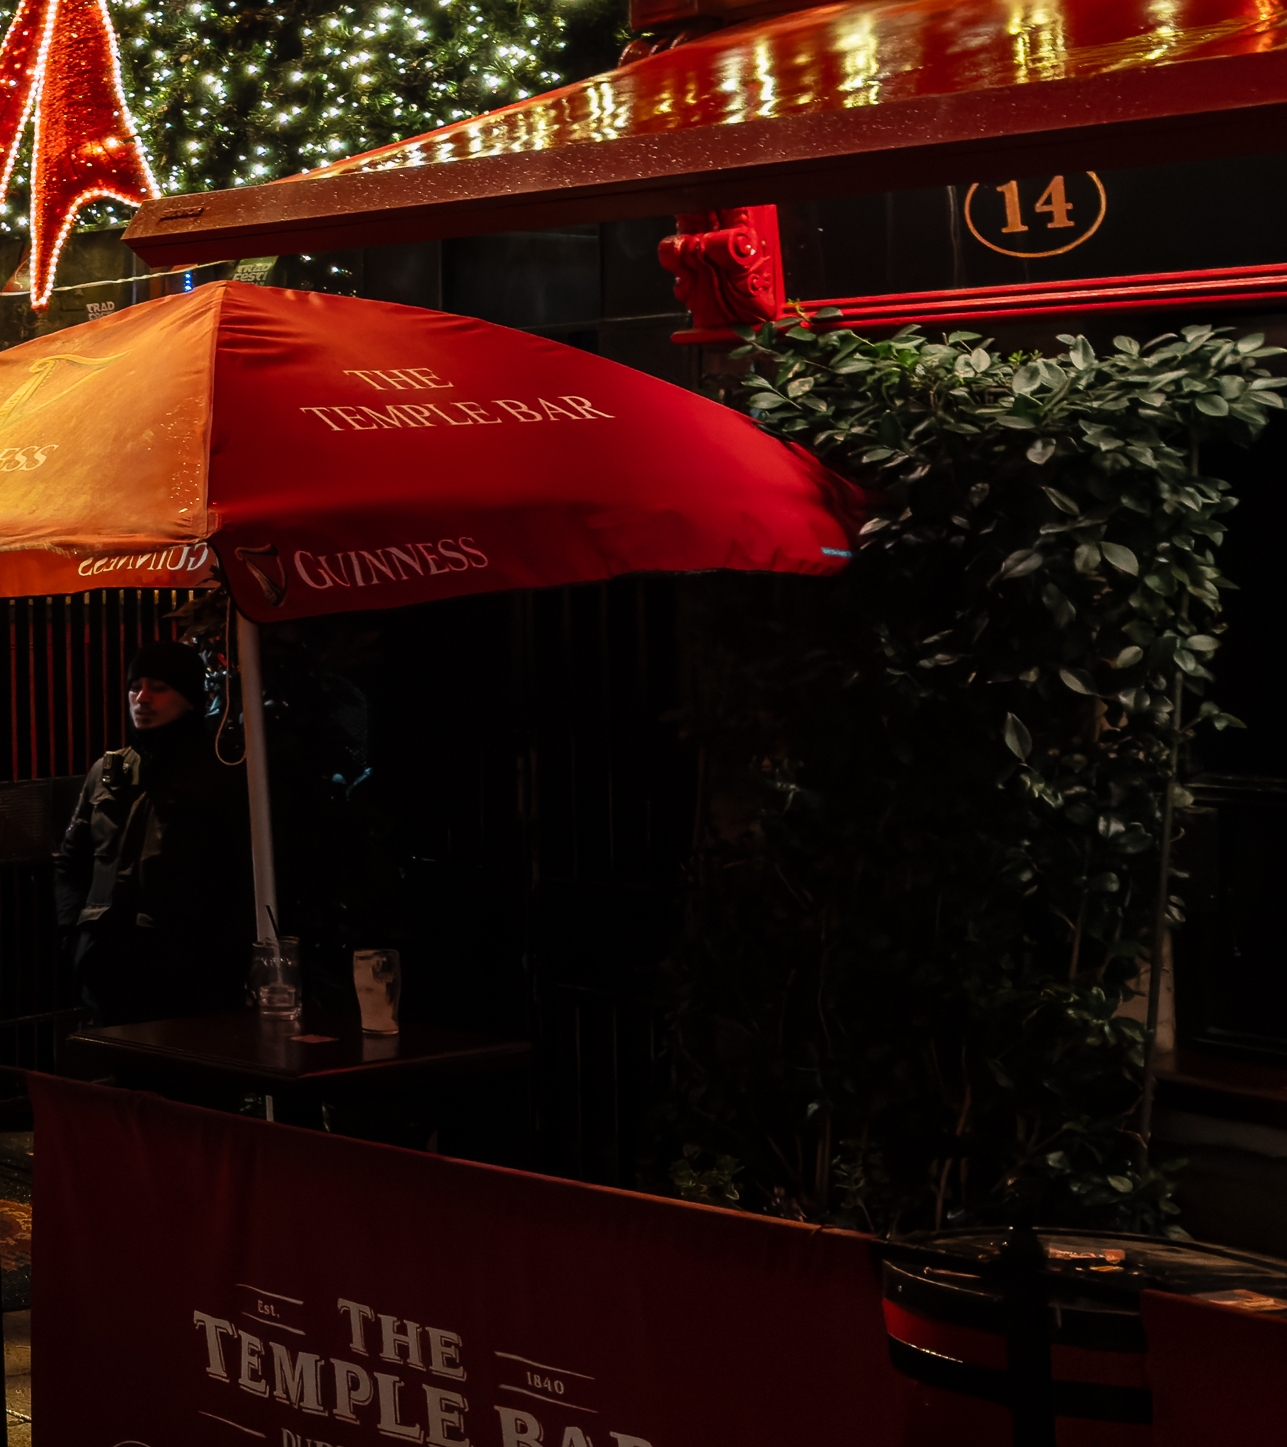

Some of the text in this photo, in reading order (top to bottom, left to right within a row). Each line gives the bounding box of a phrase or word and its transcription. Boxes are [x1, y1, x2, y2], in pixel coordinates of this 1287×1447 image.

[995, 175, 1076, 233] 14
[342, 368, 455, 391] THE
[299, 394, 616, 434] TEMPLE BAR
[293, 536, 490, 590] GUINNESS
[337, 1298, 467, 1381] THE
[194, 1310, 471, 1446] TEMPLE
[526, 1371, 565, 1395] 1840
